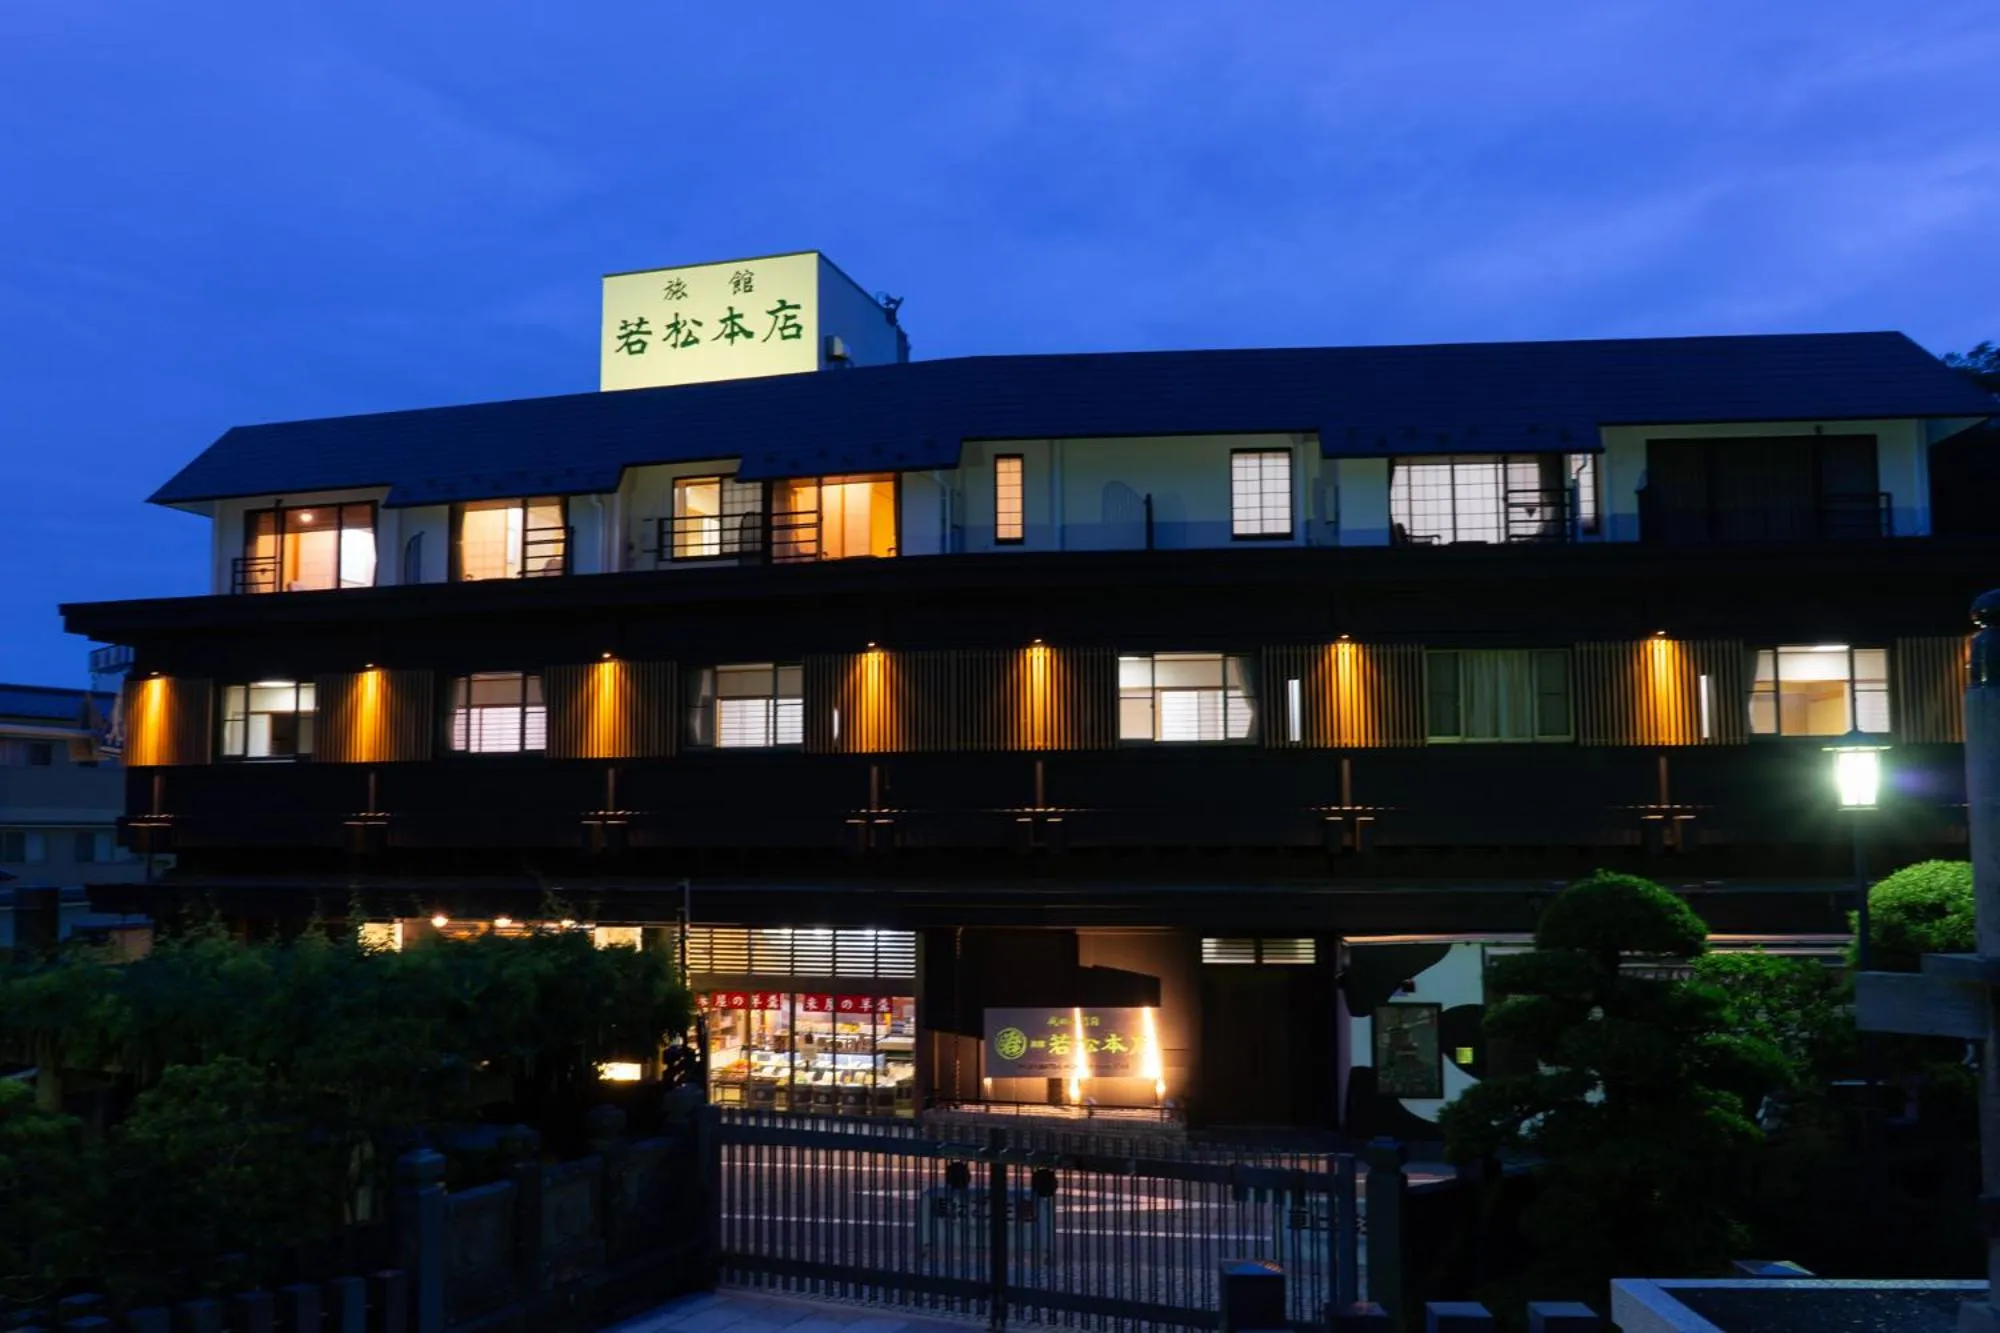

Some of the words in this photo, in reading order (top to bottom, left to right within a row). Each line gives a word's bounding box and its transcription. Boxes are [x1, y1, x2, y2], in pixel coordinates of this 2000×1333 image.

[663, 269, 755, 301] 旅館
[614, 299, 804, 356] 若松本店
